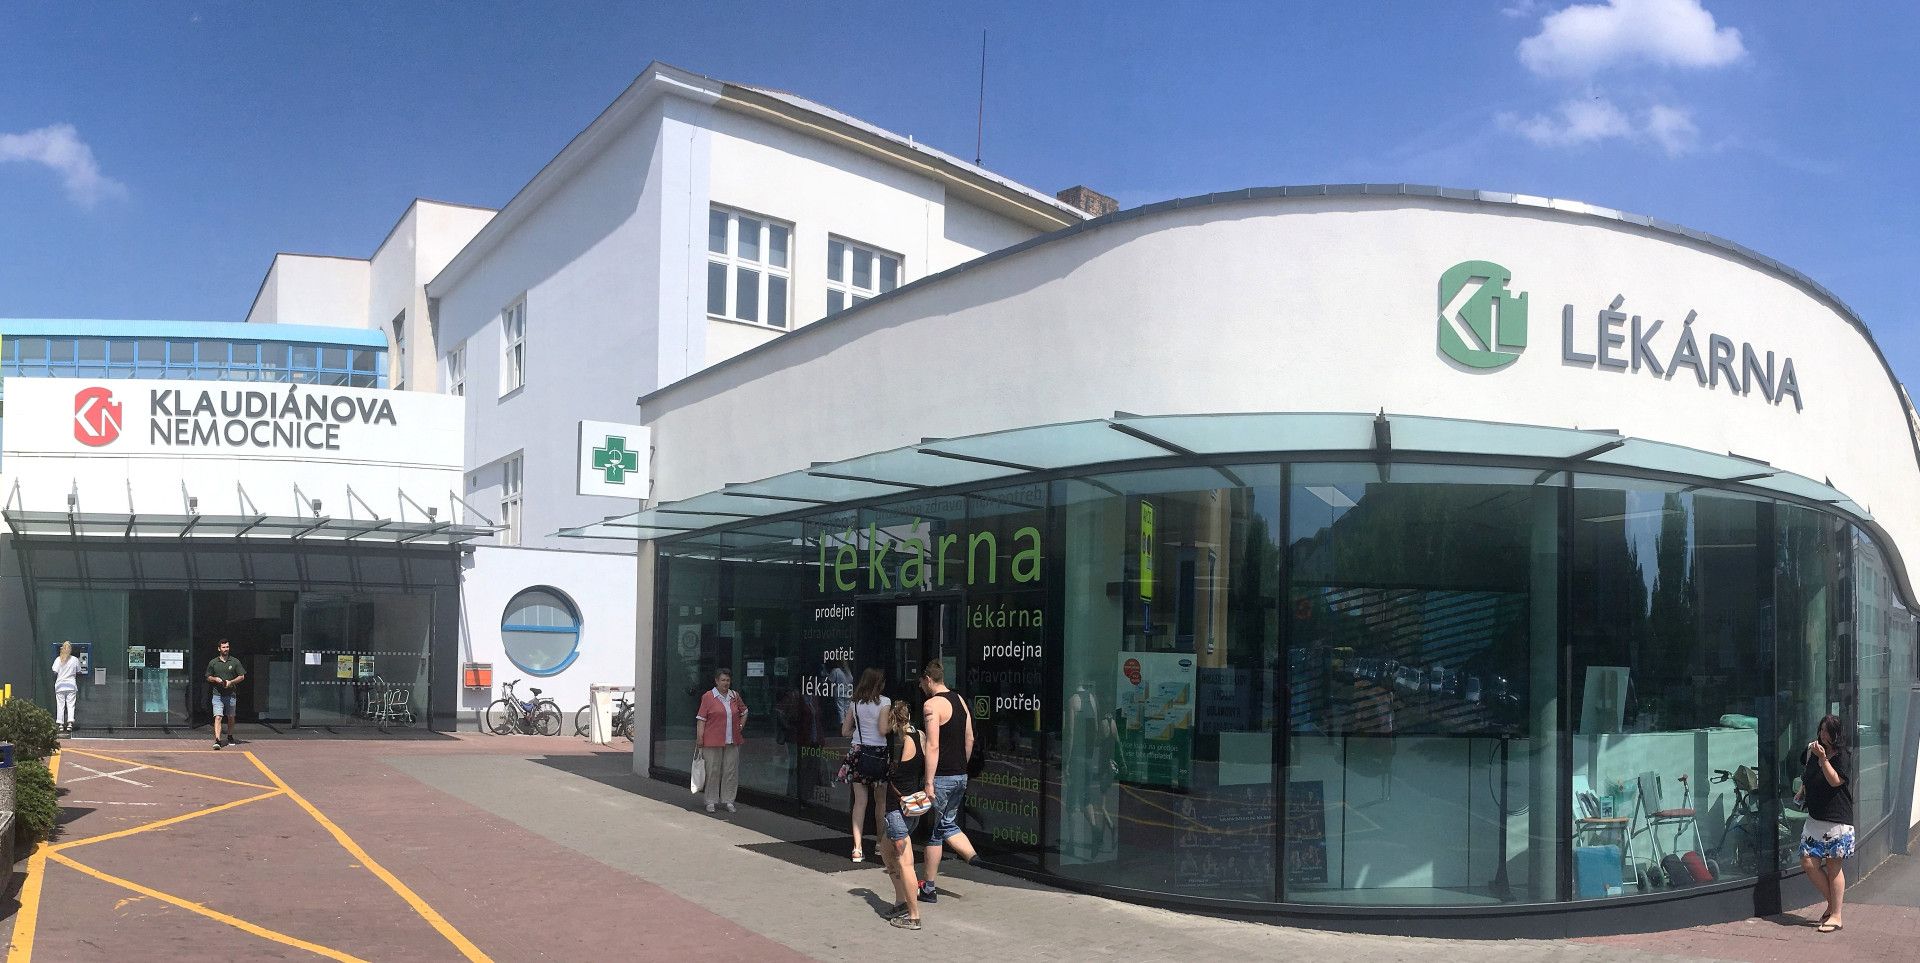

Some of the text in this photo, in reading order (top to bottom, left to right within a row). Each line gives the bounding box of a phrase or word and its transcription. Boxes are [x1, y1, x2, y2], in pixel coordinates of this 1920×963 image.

[1561, 293, 1803, 414] LÉKÁRNA
[150, 384, 397, 426] KLAUDIÁNOVA
[150, 418, 341, 450] NEMOCNICE
[818, 517, 1042, 593] lékárna
[967, 603, 1043, 628] lékárna
[983, 640, 1042, 661] prodejna
[801, 675, 854, 698] lékárna
[995, 693, 1041, 712] potřeb
[981, 771, 1040, 792] prodejna
[992, 825, 1039, 845] potřeb
